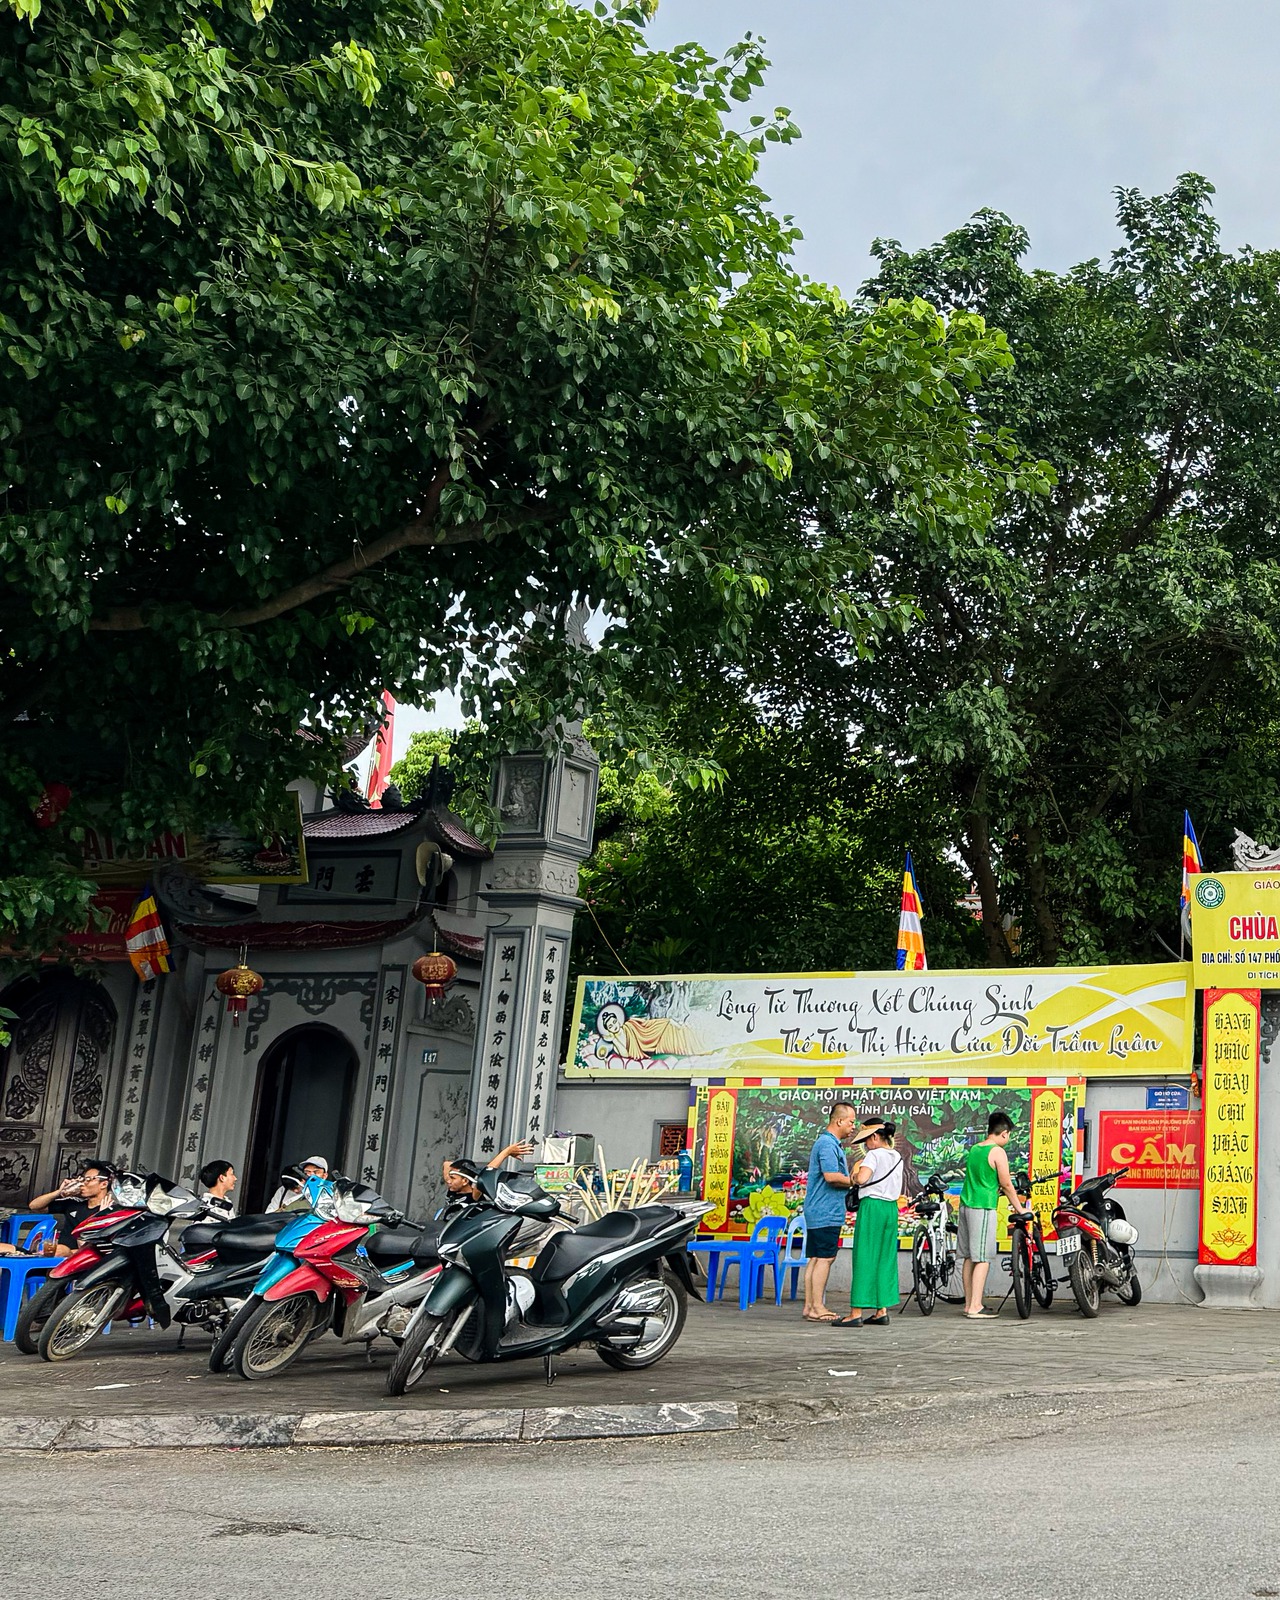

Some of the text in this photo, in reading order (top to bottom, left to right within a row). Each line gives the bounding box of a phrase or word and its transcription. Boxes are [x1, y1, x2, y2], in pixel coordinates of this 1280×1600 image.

[1254, 879, 1280, 889] GIÁO
[1229, 911, 1279, 940] CHÙA
[1201, 952, 1215, 965] ĐỊA
[1217, 949, 1233, 963] CHỈ:
[1235, 949, 1246, 963] SỐ
[1248, 953, 1262, 963] 147
[1264, 949, 1280, 963] PHỐ
[1259, 970, 1278, 979] TÍCH
[717, 984, 1037, 1036] Lòng Từ Thương Xót Chúng Sinh
[780, 1024, 1162, 1058] Thế Tôn Thị Hiện Cứu Đời Trầm Luân
[1215, 1039, 1250, 1063] PHÚC
[423, 1052, 437, 1063] 147
[1214, 1073, 1249, 1094] THAY
[779, 1087, 981, 1103] GIÁO HỘI PHẬT GIÁO VIỆT NAM
[855, 1104, 881, 1115] TĨNH
[884, 1104, 906, 1115] LÂU
[1110, 1133, 1197, 1165] CẤM
[1213, 1131, 1249, 1157] PHẬT
[1142, 1165, 1165, 1179] TRƯỚC
[1166, 1165, 1180, 1179] CỬA
[1181, 1166, 1200, 1179] CHÙA
[1207, 1161, 1253, 1184] GIÁNG
[1212, 1196, 1247, 1218] SINH
